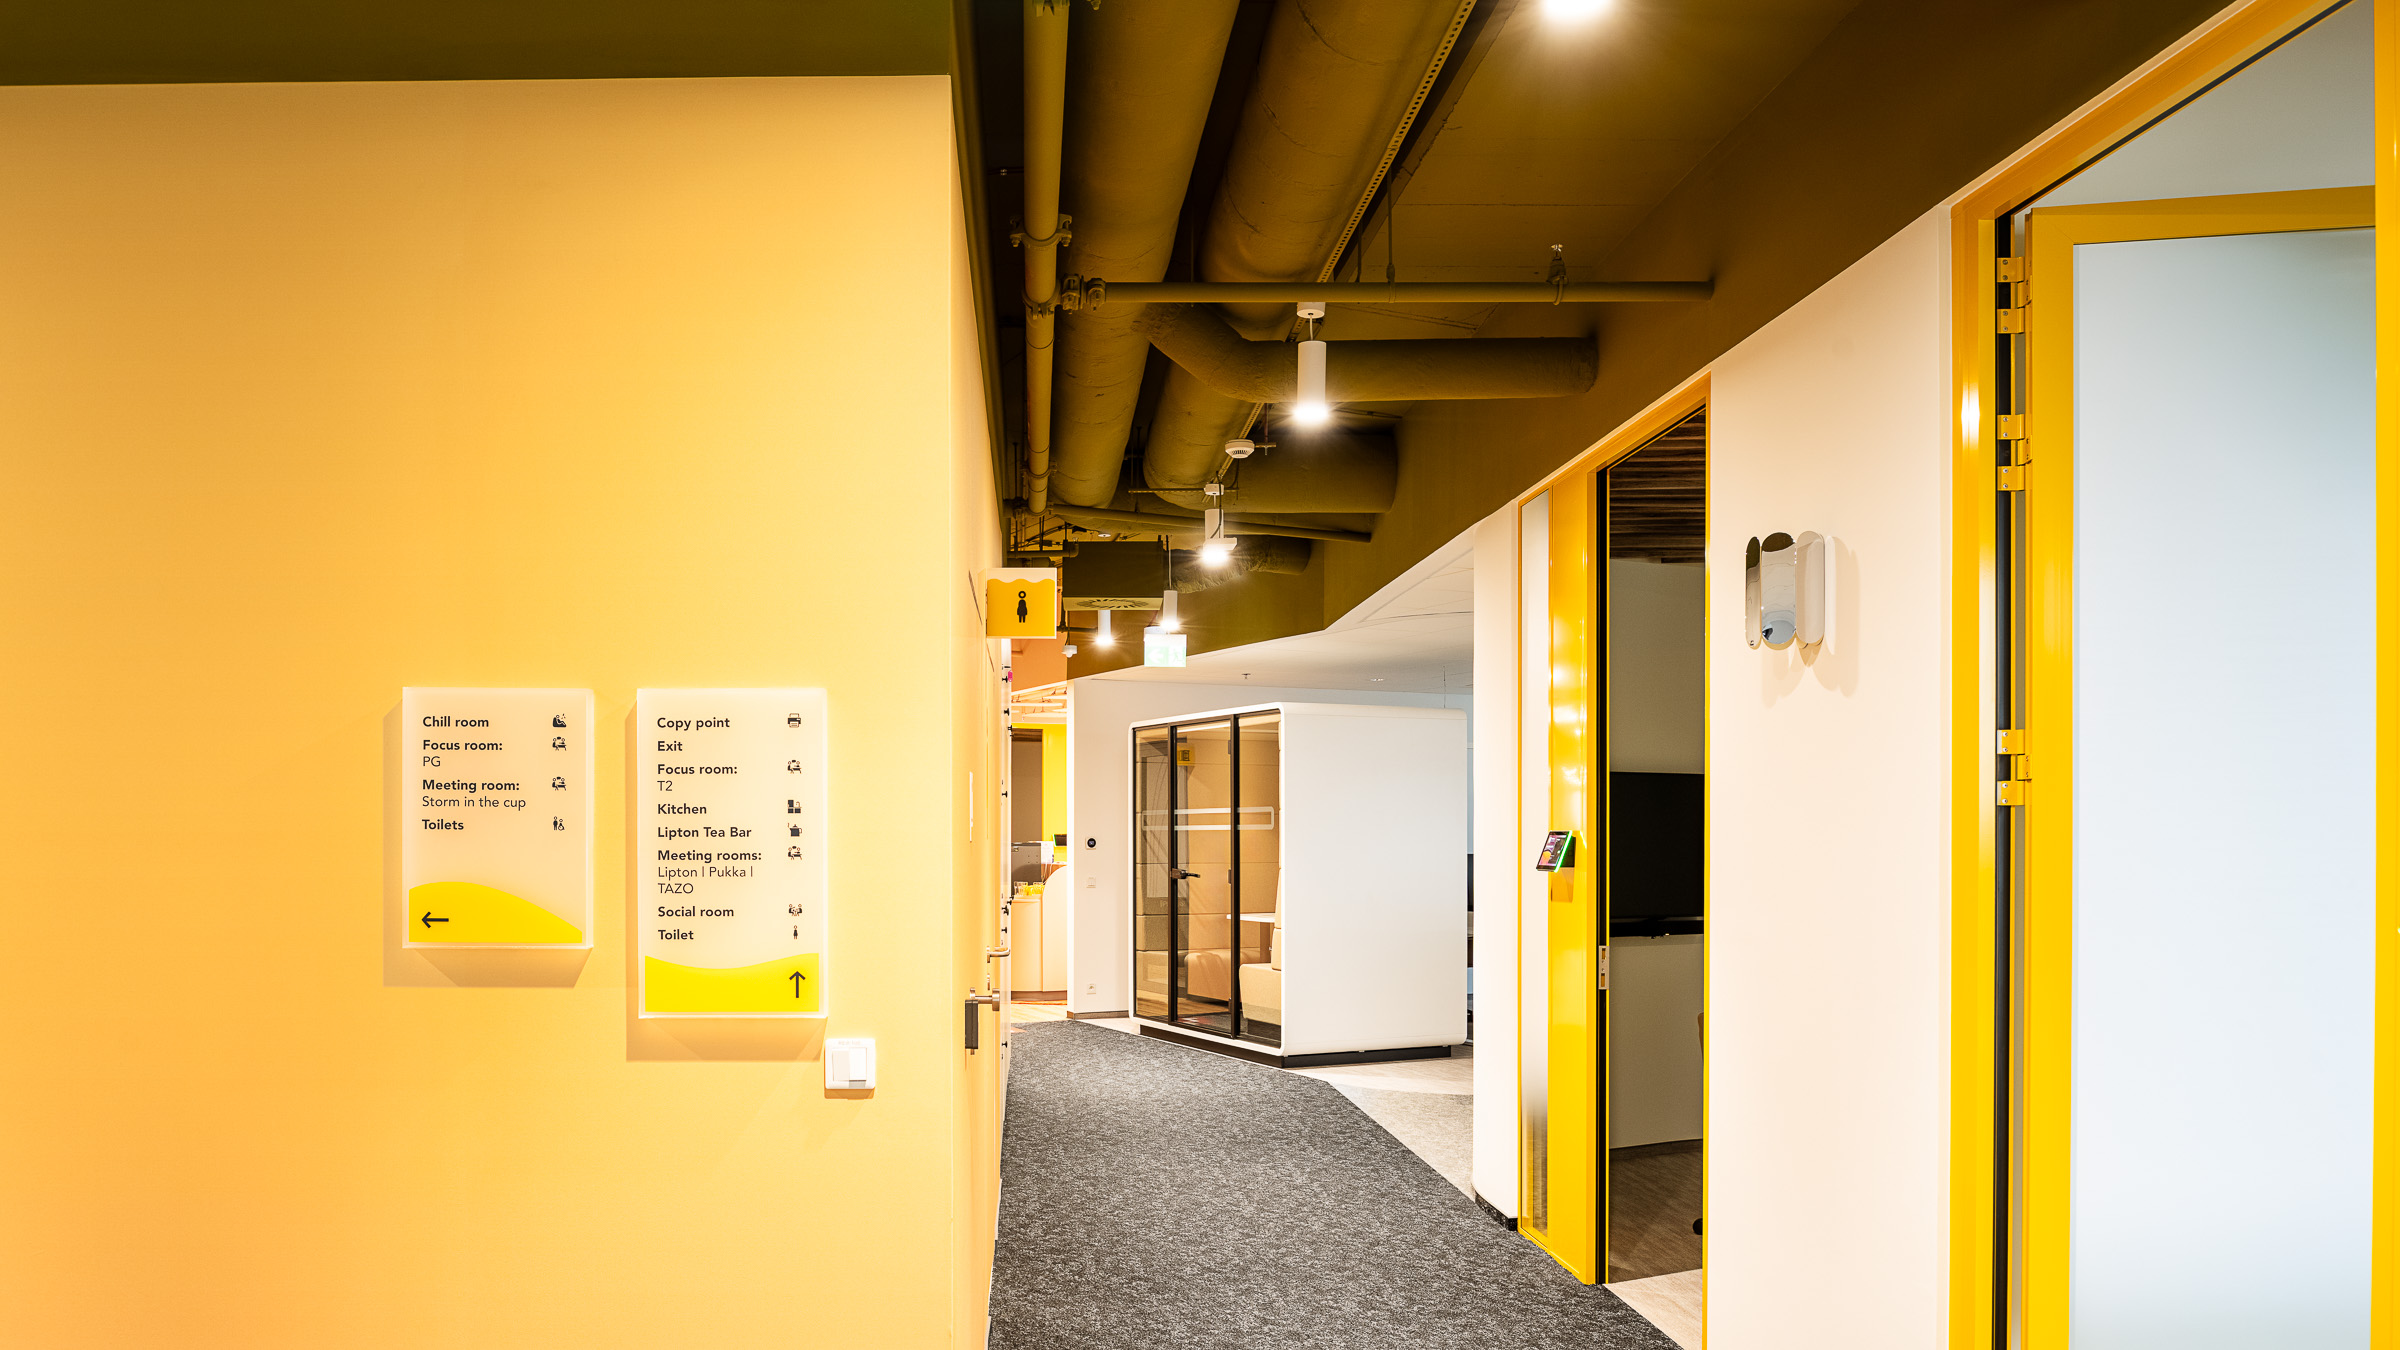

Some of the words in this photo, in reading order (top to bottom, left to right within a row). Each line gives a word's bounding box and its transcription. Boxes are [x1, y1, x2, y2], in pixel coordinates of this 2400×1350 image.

[422, 715, 451, 728] Chill
[455, 719, 490, 728] room
[656, 717, 692, 732] Copy
[695, 716, 731, 731] point
[422, 739, 461, 751] Focus
[464, 742, 503, 751] room:
[657, 740, 683, 752] Exit
[422, 755, 441, 768] PG
[657, 763, 695, 775] Focus
[699, 766, 738, 775] room:
[422, 779, 477, 794] Meeting
[481, 782, 520, 791] room:
[656, 780, 673, 792] T2
[422, 795, 460, 807] Storm
[464, 795, 475, 807] in
[478, 795, 500, 807] the
[503, 799, 527, 812] cup
[657, 802, 707, 815] Kitchen
[421, 818, 465, 831] Toilets
[657, 826, 699, 841] Lipton
[702, 826, 726, 838] Tea
[730, 826, 752, 838] Bar
[657, 849, 712, 864] Meeting
[716, 852, 762, 861] rooms:
[657, 866, 698, 882] Lipton
[709, 865, 746, 878] Pukka
[657, 882, 694, 895] TAZO
[657, 905, 696, 918] Social
[700, 908, 735, 917] room
[657, 928, 695, 941] Toilet
